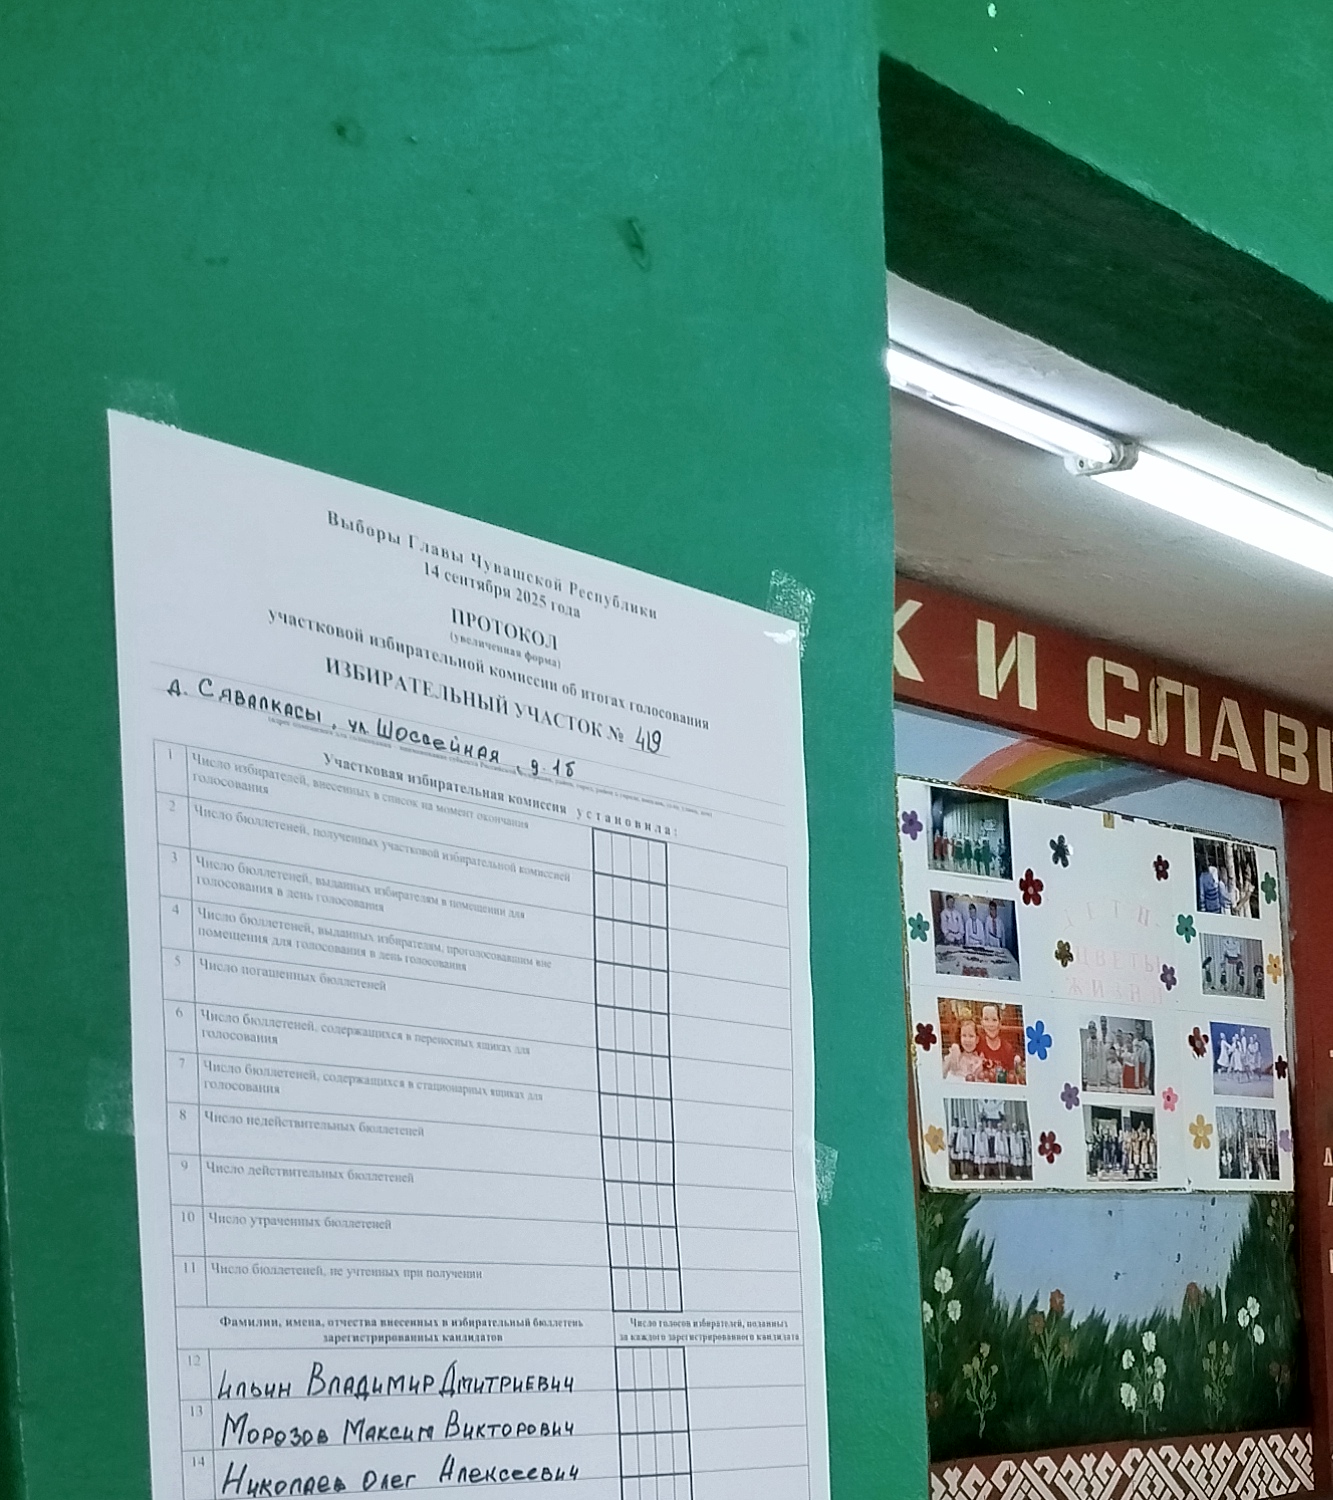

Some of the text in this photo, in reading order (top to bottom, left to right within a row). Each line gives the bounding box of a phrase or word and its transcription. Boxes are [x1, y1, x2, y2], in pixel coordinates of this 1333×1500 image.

[327, 510, 657, 619] Выборы Главы Чувашской Республики
[424, 562, 581, 618] 14 сентября 2025 года
[450, 607, 558, 650] ПРОТОКОЛ
[268, 609, 709, 730] участковой избирательной комиссии об итогах голосования
[977, 619, 1038, 710] И
[325, 657, 508, 715] ИЗБИРАТЕЛЬНЫЙ
[514, 701, 603, 739] УЧАСТОК
[606, 725, 624, 743] №
[168, 748, 173, 760] 1
[193, 772, 269, 795] голосования
[323, 752, 404, 782] Участковая
[408, 773, 505, 802] избирательная
[508, 792, 567, 816] комиссия
[169, 801, 175, 811] 2
[171, 852, 178, 863] 3
[196, 875, 273, 895] голосования
[286, 890, 313, 901] день
[316, 892, 385, 912] голосования
[172, 904, 179, 915] 4
[174, 955, 387, 992] 5 Число погашенных бюллетеней
[175, 1007, 183, 1018] 6
[201, 1028, 278, 1045] голосования
[178, 1058, 185, 1068] 7
[179, 1110, 424, 1137] 8 Число недействительных бюллетеней
[181, 1160, 414, 1184] 9 Число действительных бюллетеней
[181, 1212, 392, 1230] 10 Число утраченных бюллетеней
[184, 1262, 196, 1273] 11
[211, 1262, 249, 1275] Число
[252, 1264, 327, 1279] бюллетеней,
[330, 1267, 343, 1276] не
[403, 1268, 423, 1280] при
[426, 1268, 482, 1280] получении
[219, 1316, 282, 1328] Фамилии,
[285, 1318, 325, 1328] имена,
[327, 1318, 377, 1327] отчества
[380, 1319, 438, 1327] внесенных
[451, 1317, 531, 1329] избирательный
[533, 1317, 584, 1327] бюллетень
[323, 1334, 503, 1345] зарегистрированных кандидатов
